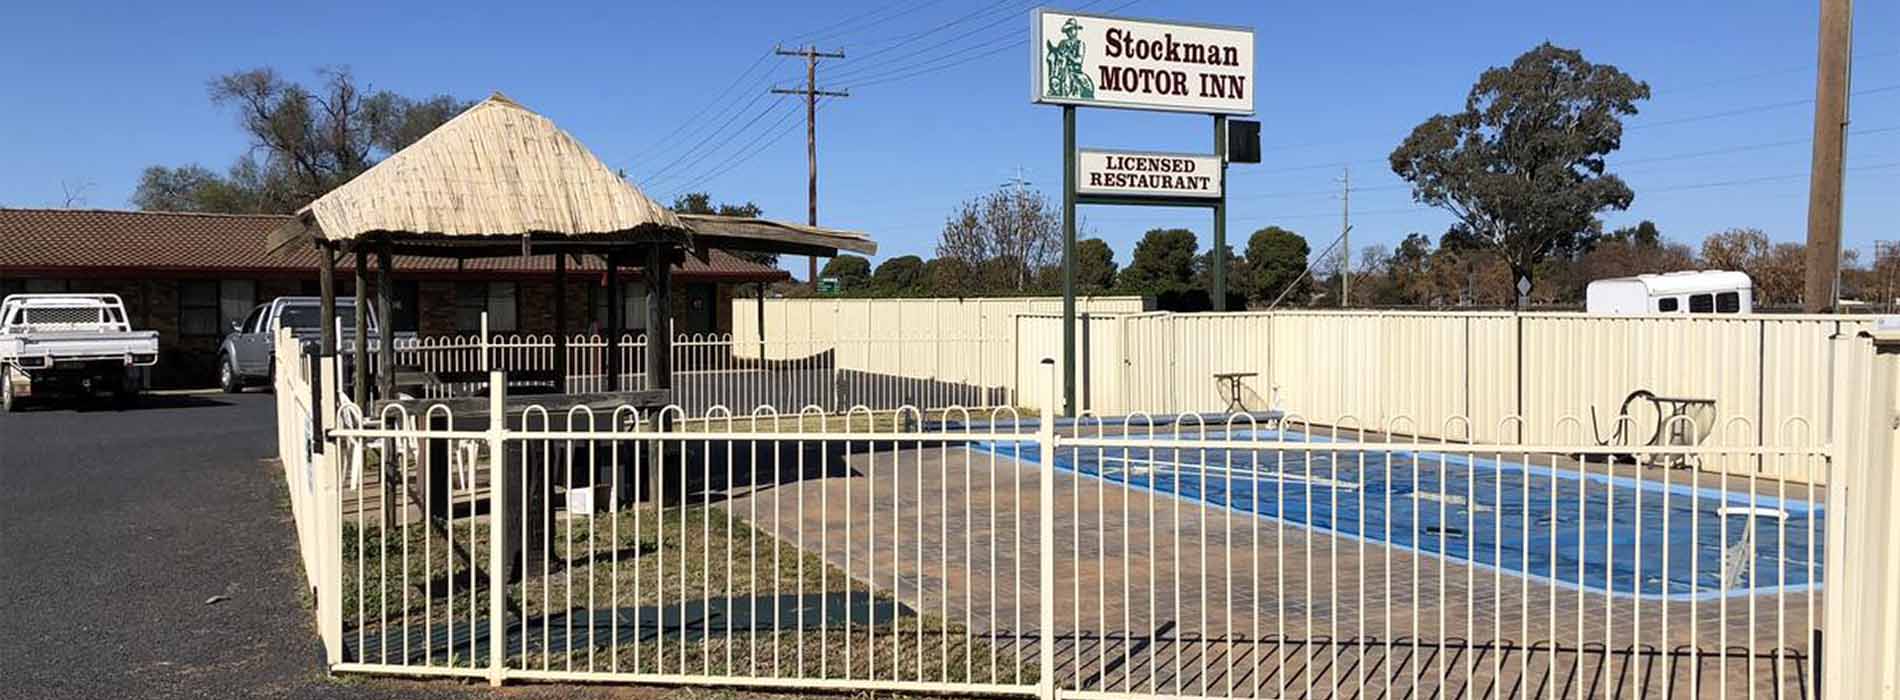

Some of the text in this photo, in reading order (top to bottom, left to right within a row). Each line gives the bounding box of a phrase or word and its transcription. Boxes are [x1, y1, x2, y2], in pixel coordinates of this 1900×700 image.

[1106, 27, 1239, 66] Stockman
[1098, 65, 1246, 99] MOTOR INN
[1106, 156, 1196, 173] LICENSED
[1090, 172, 1211, 190] RESTAURANT
